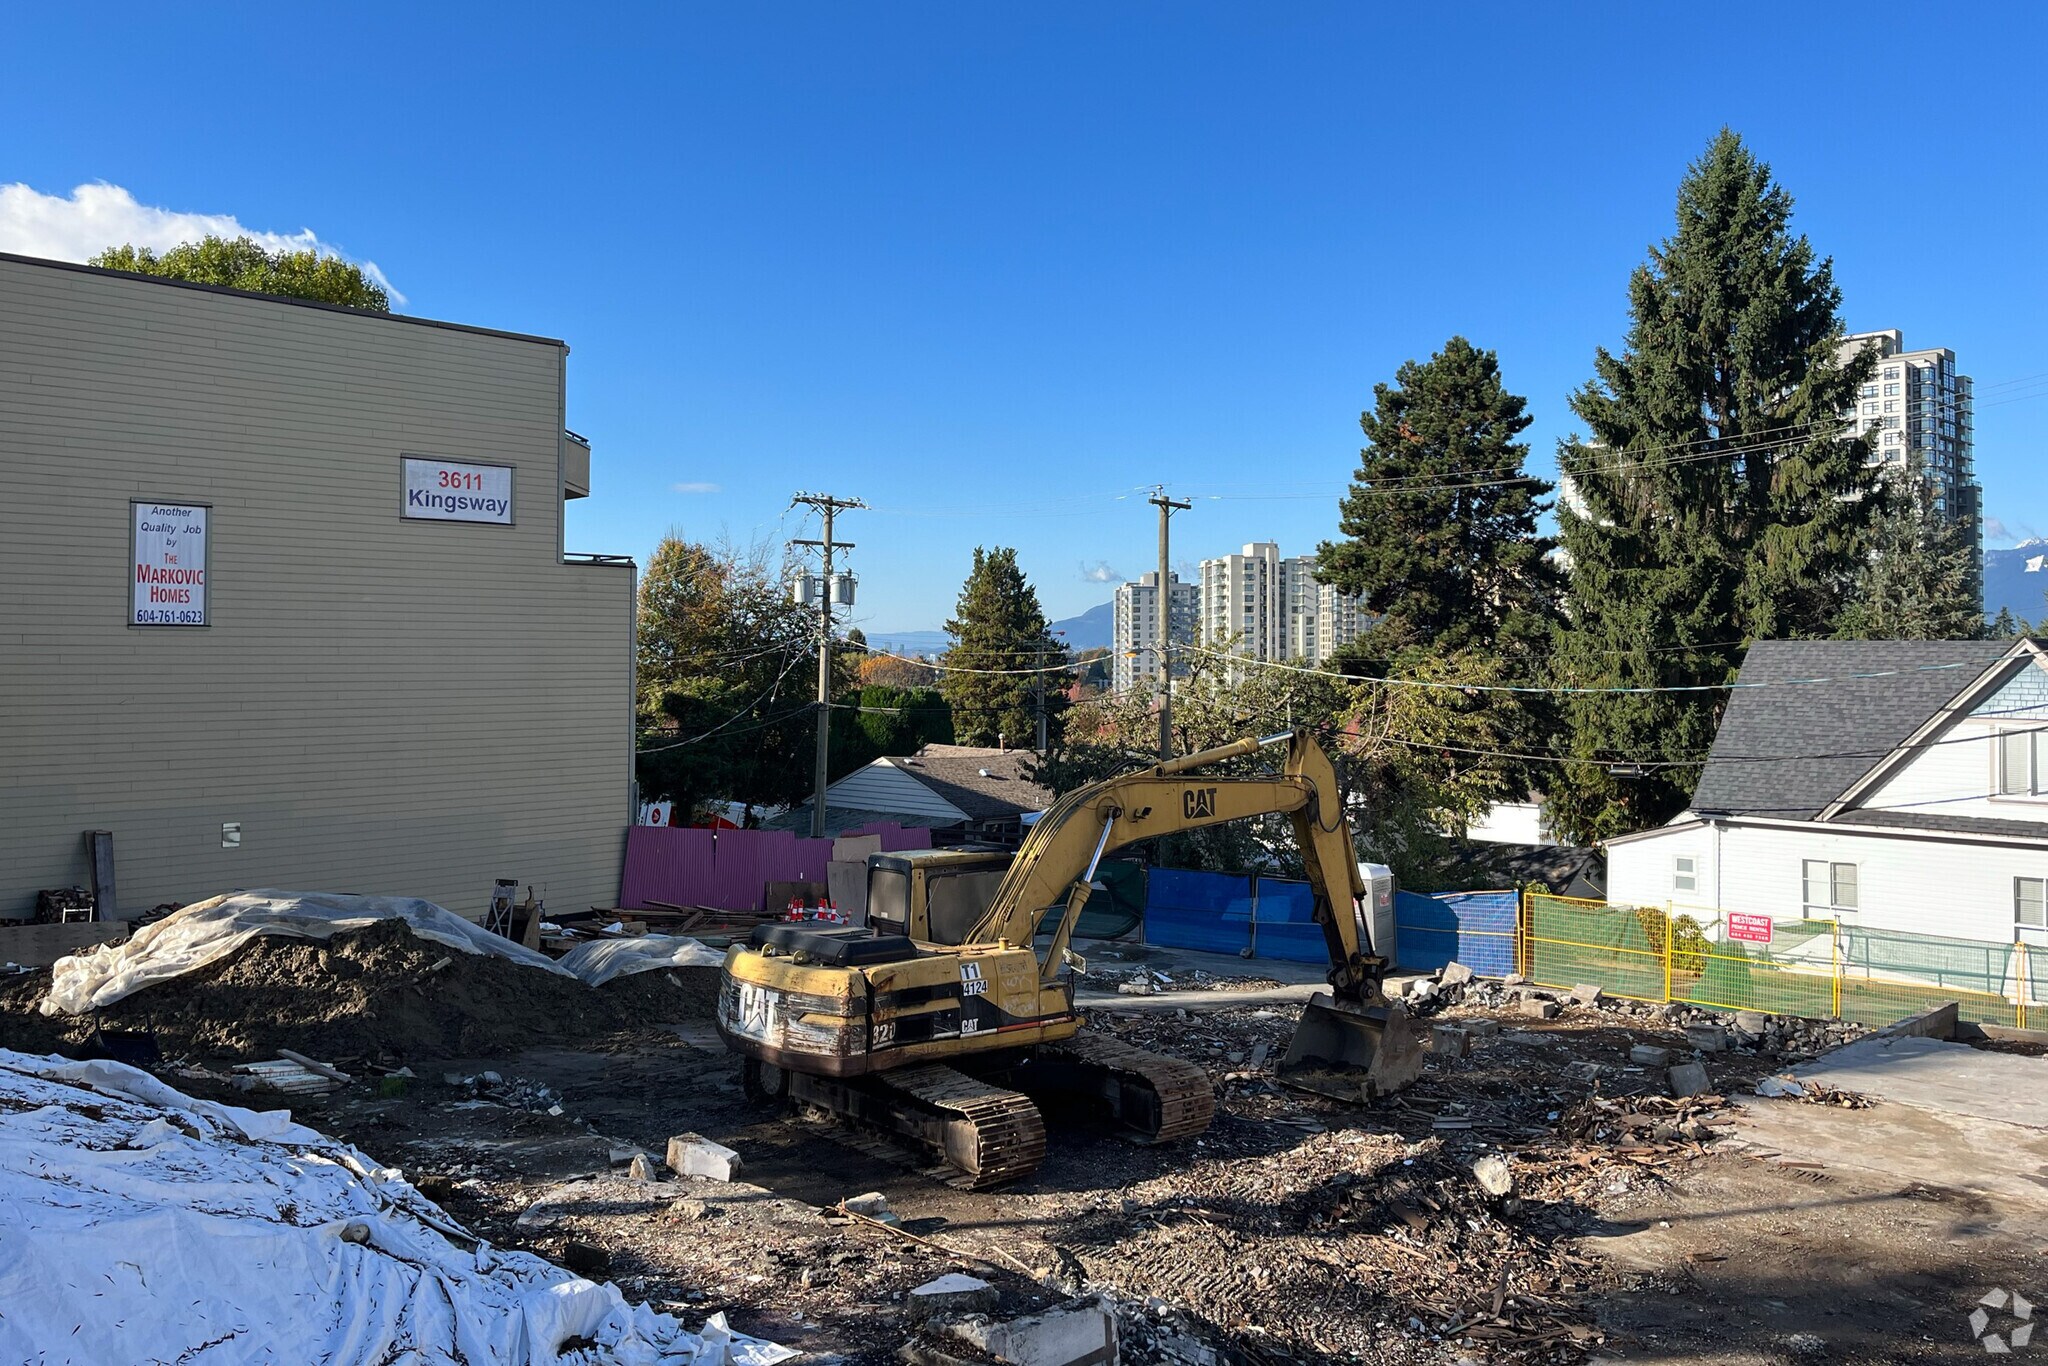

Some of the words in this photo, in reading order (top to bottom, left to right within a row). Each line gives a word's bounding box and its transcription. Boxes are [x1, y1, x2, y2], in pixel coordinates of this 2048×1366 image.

[438, 470, 482, 491] 3611
[408, 488, 509, 517] Kingsway
[151, 506, 192, 517] Another
[141, 521, 177, 536] Quality
[183, 524, 202, 535] Job
[166, 537, 177, 548] by
[164, 552, 178, 565] THE
[137, 563, 204, 586] MARKOVIC
[150, 585, 191, 604] HOMES
[137, 609, 203, 624] 604-761-0623
[1183, 787, 1217, 820] CAT
[1731, 914, 1769, 927] WESTCOAST
[961, 963, 979, 980] T1
[963, 980, 988, 996] 4124
[738, 983, 779, 1042] CAT
[961, 1018, 979, 1033] CAT
